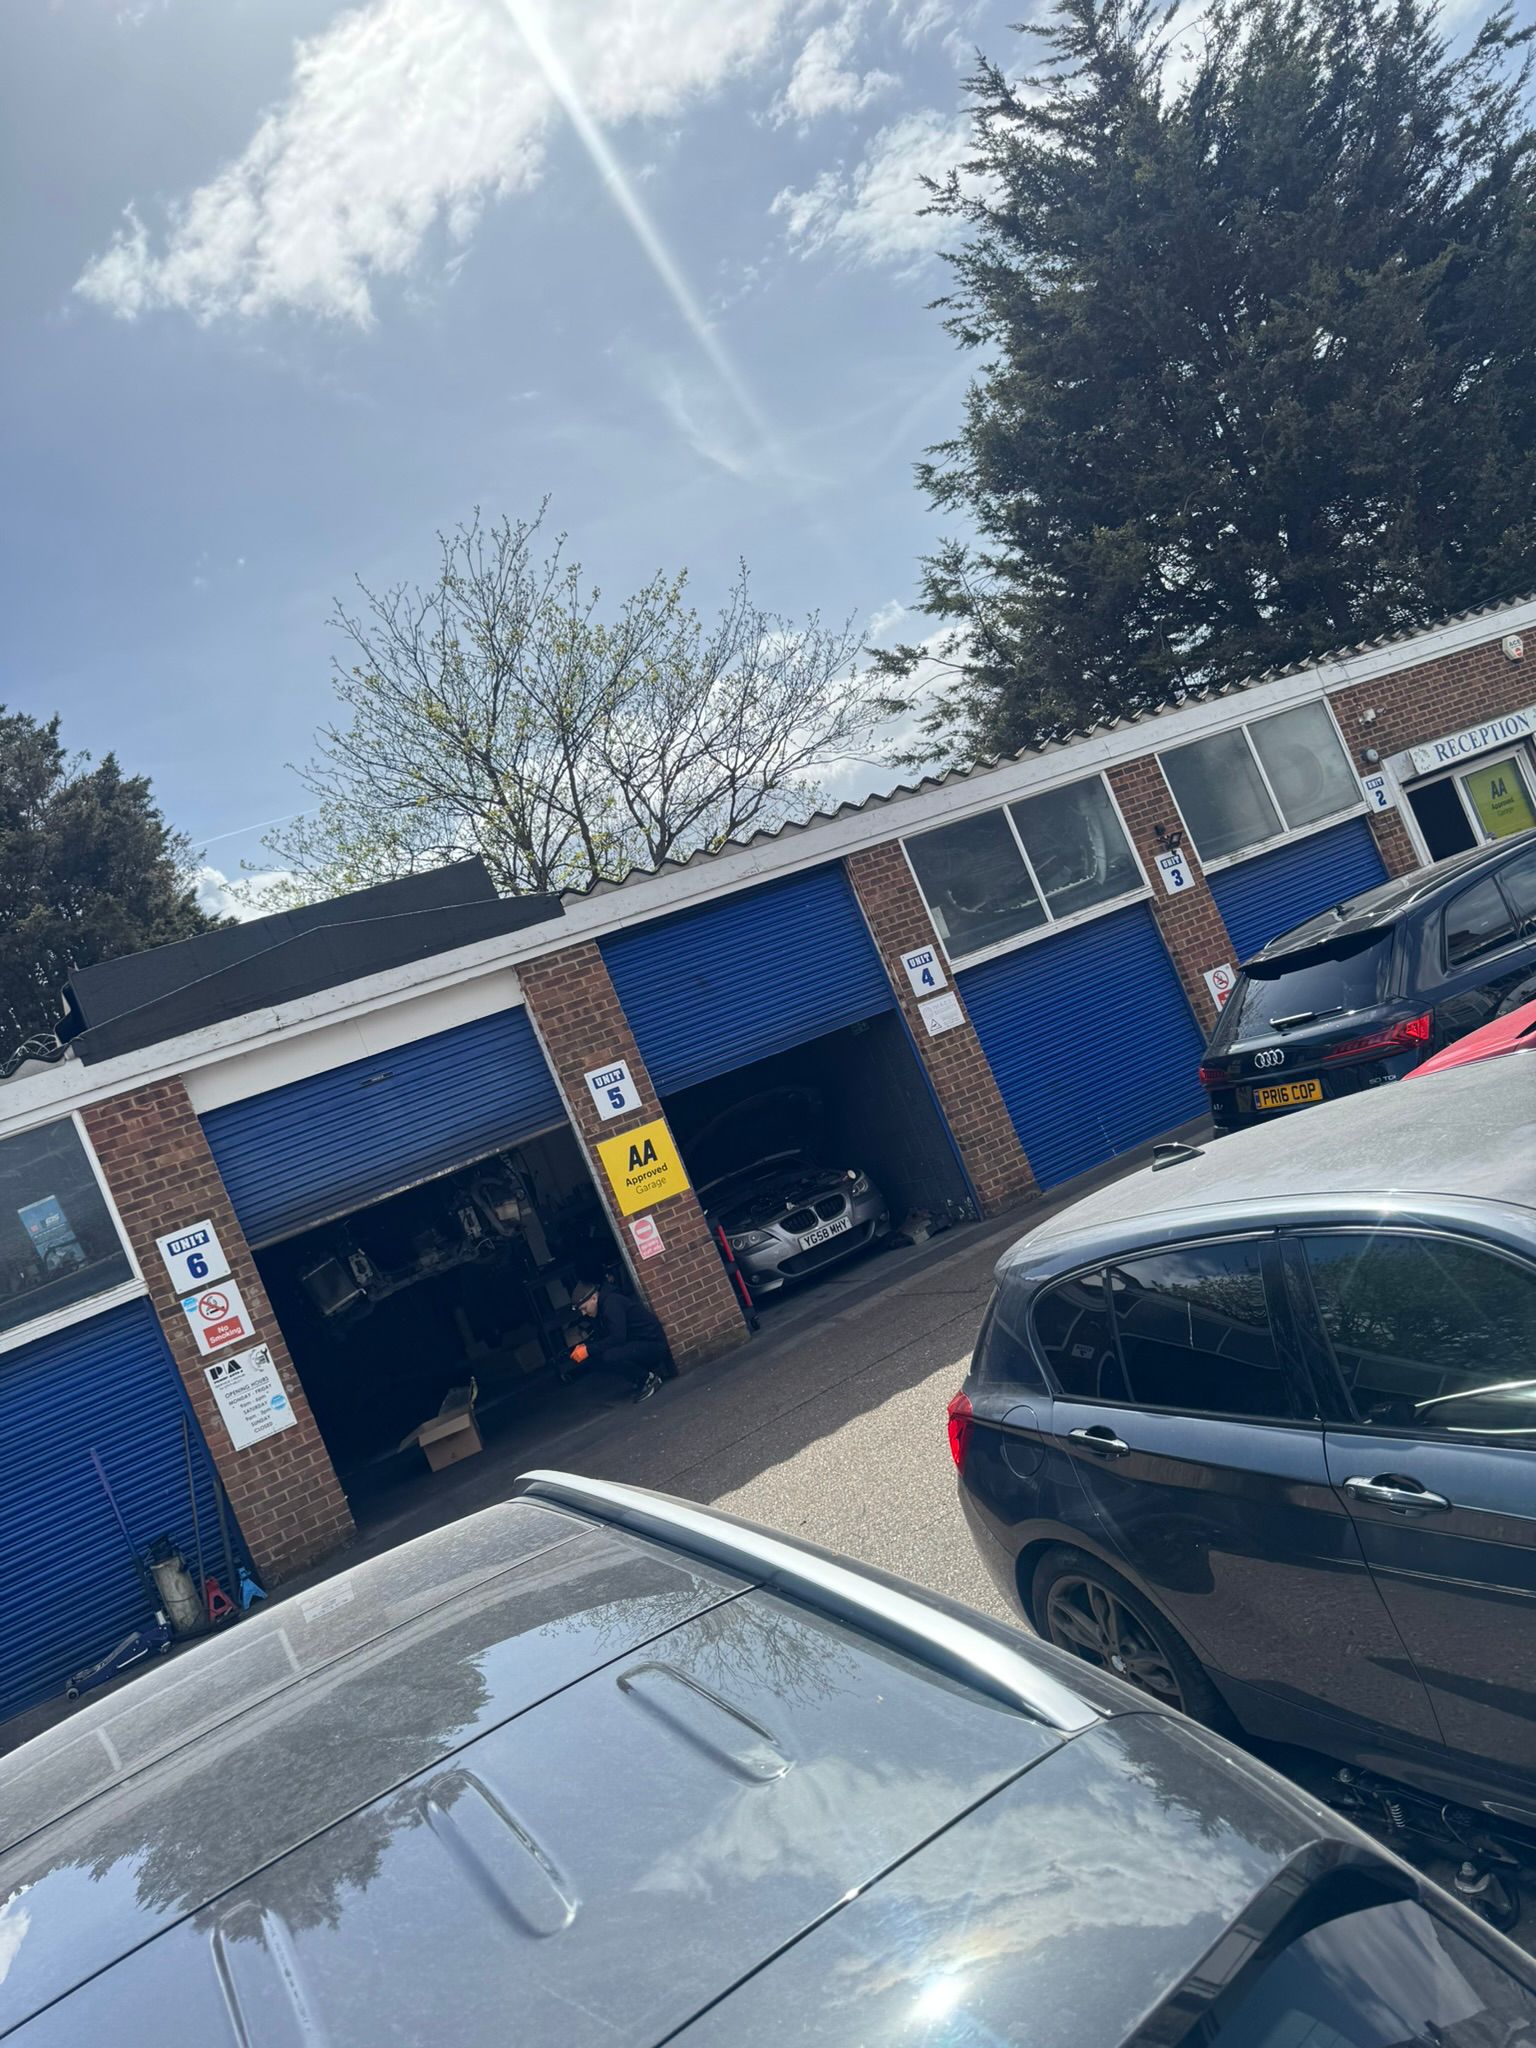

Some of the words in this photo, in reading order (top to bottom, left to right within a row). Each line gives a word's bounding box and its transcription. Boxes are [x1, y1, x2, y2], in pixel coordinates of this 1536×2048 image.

[1433, 712, 1531, 762] RECEPTION
[1376, 790, 1387, 806] 2
[1490, 777, 1508, 799] AA
[1161, 855, 1181, 869] UNIT
[1170, 869, 1184, 887] 3
[909, 953, 931, 968] UNIT
[922, 967, 935, 987] 4
[595, 1070, 622, 1088] UNIT
[607, 1087, 626, 1109] 5
[1262, 1087, 1290, 1105] PR16
[1293, 1082, 1316, 1100] COP
[628, 1138, 658, 1172] AA
[625, 1162, 668, 1187] Approved
[635, 1176, 667, 1195] Garage
[829, 1220, 849, 1237] MHY
[171, 1232, 206, 1254] UNIT
[186, 1252, 209, 1279] 6
[209, 1325, 242, 1345] Smoking
[217, 1323, 229, 1334] No
[225, 1384, 250, 1399] OPENING
[250, 1376, 269, 1387] HOURS
[228, 1393, 251, 1406] MONDAY
[254, 1383, 272, 1395] FRIDAY
[243, 1400, 268, 1415] SATURDAY
[251, 1414, 271, 1428] SUNDAY
[254, 1421, 273, 1434] CLOSED
